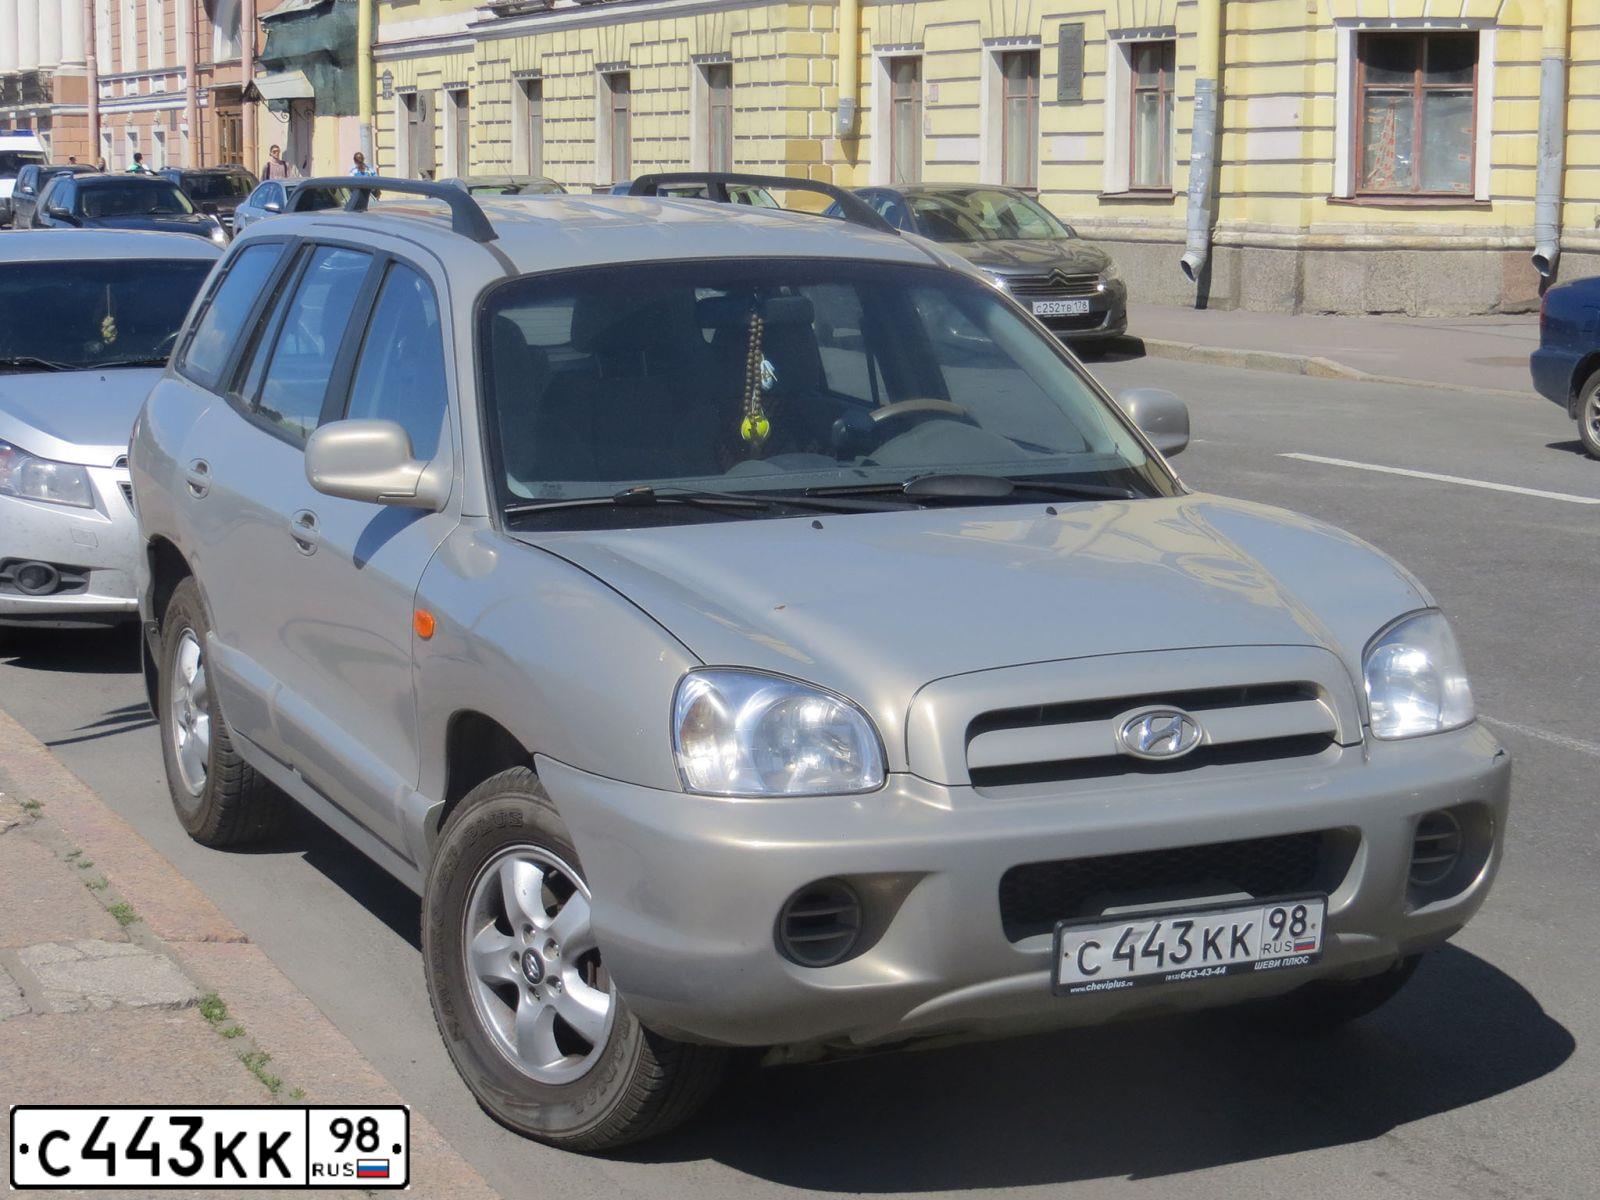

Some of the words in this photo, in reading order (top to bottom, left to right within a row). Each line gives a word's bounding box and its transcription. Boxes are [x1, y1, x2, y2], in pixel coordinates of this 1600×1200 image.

[1076, 919, 1254, 976] С443КК
[1268, 904, 1308, 941] 98
[1262, 940, 1293, 955] RUS
[1254, 960, 1281, 970] ШЕВИ
[1281, 956, 1310, 968] ПЛЮС
[1070, 979, 1134, 994] www.cheviplus.ru
